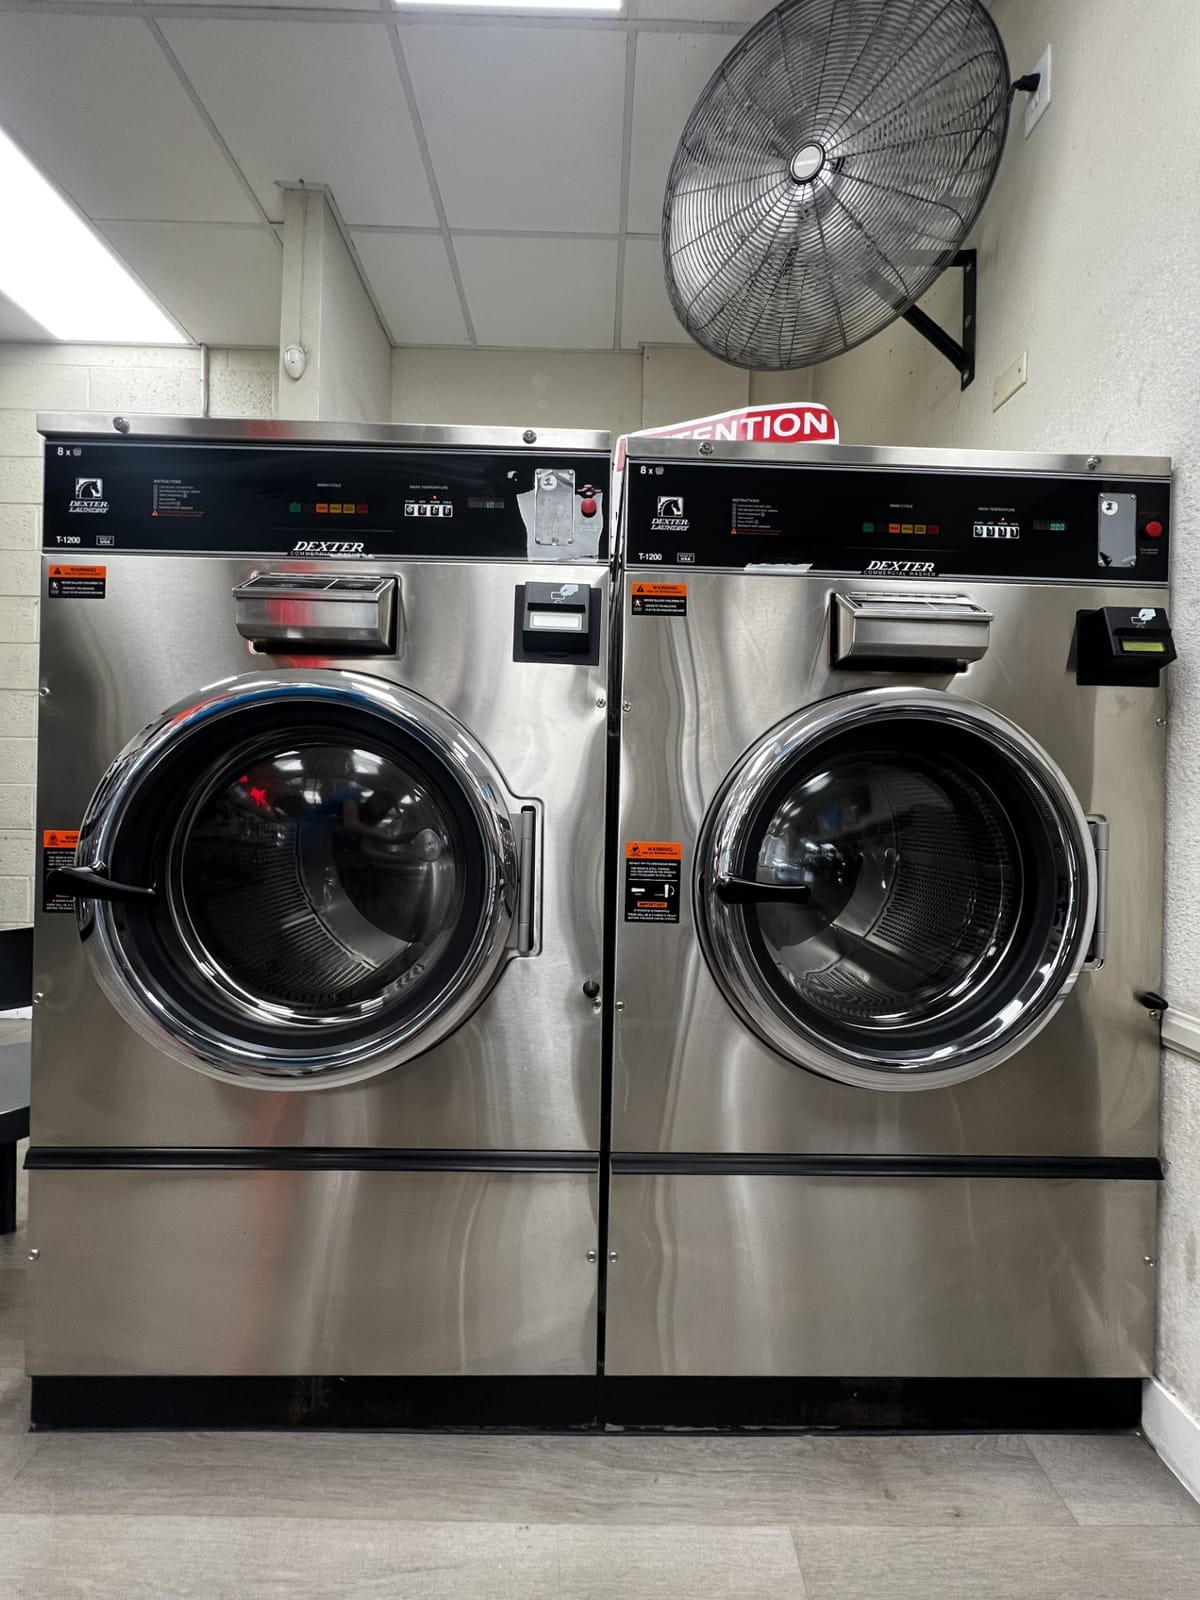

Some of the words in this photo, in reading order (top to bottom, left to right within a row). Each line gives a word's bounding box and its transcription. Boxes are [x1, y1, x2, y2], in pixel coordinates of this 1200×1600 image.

[57, 447, 64, 456] 8
[640, 465, 647, 475] 8
[56, 535, 81, 544] T-1200
[292, 541, 367, 552] DEXTER
[638, 552, 663, 561] T-1200
[866, 560, 938, 572] DEXTER
